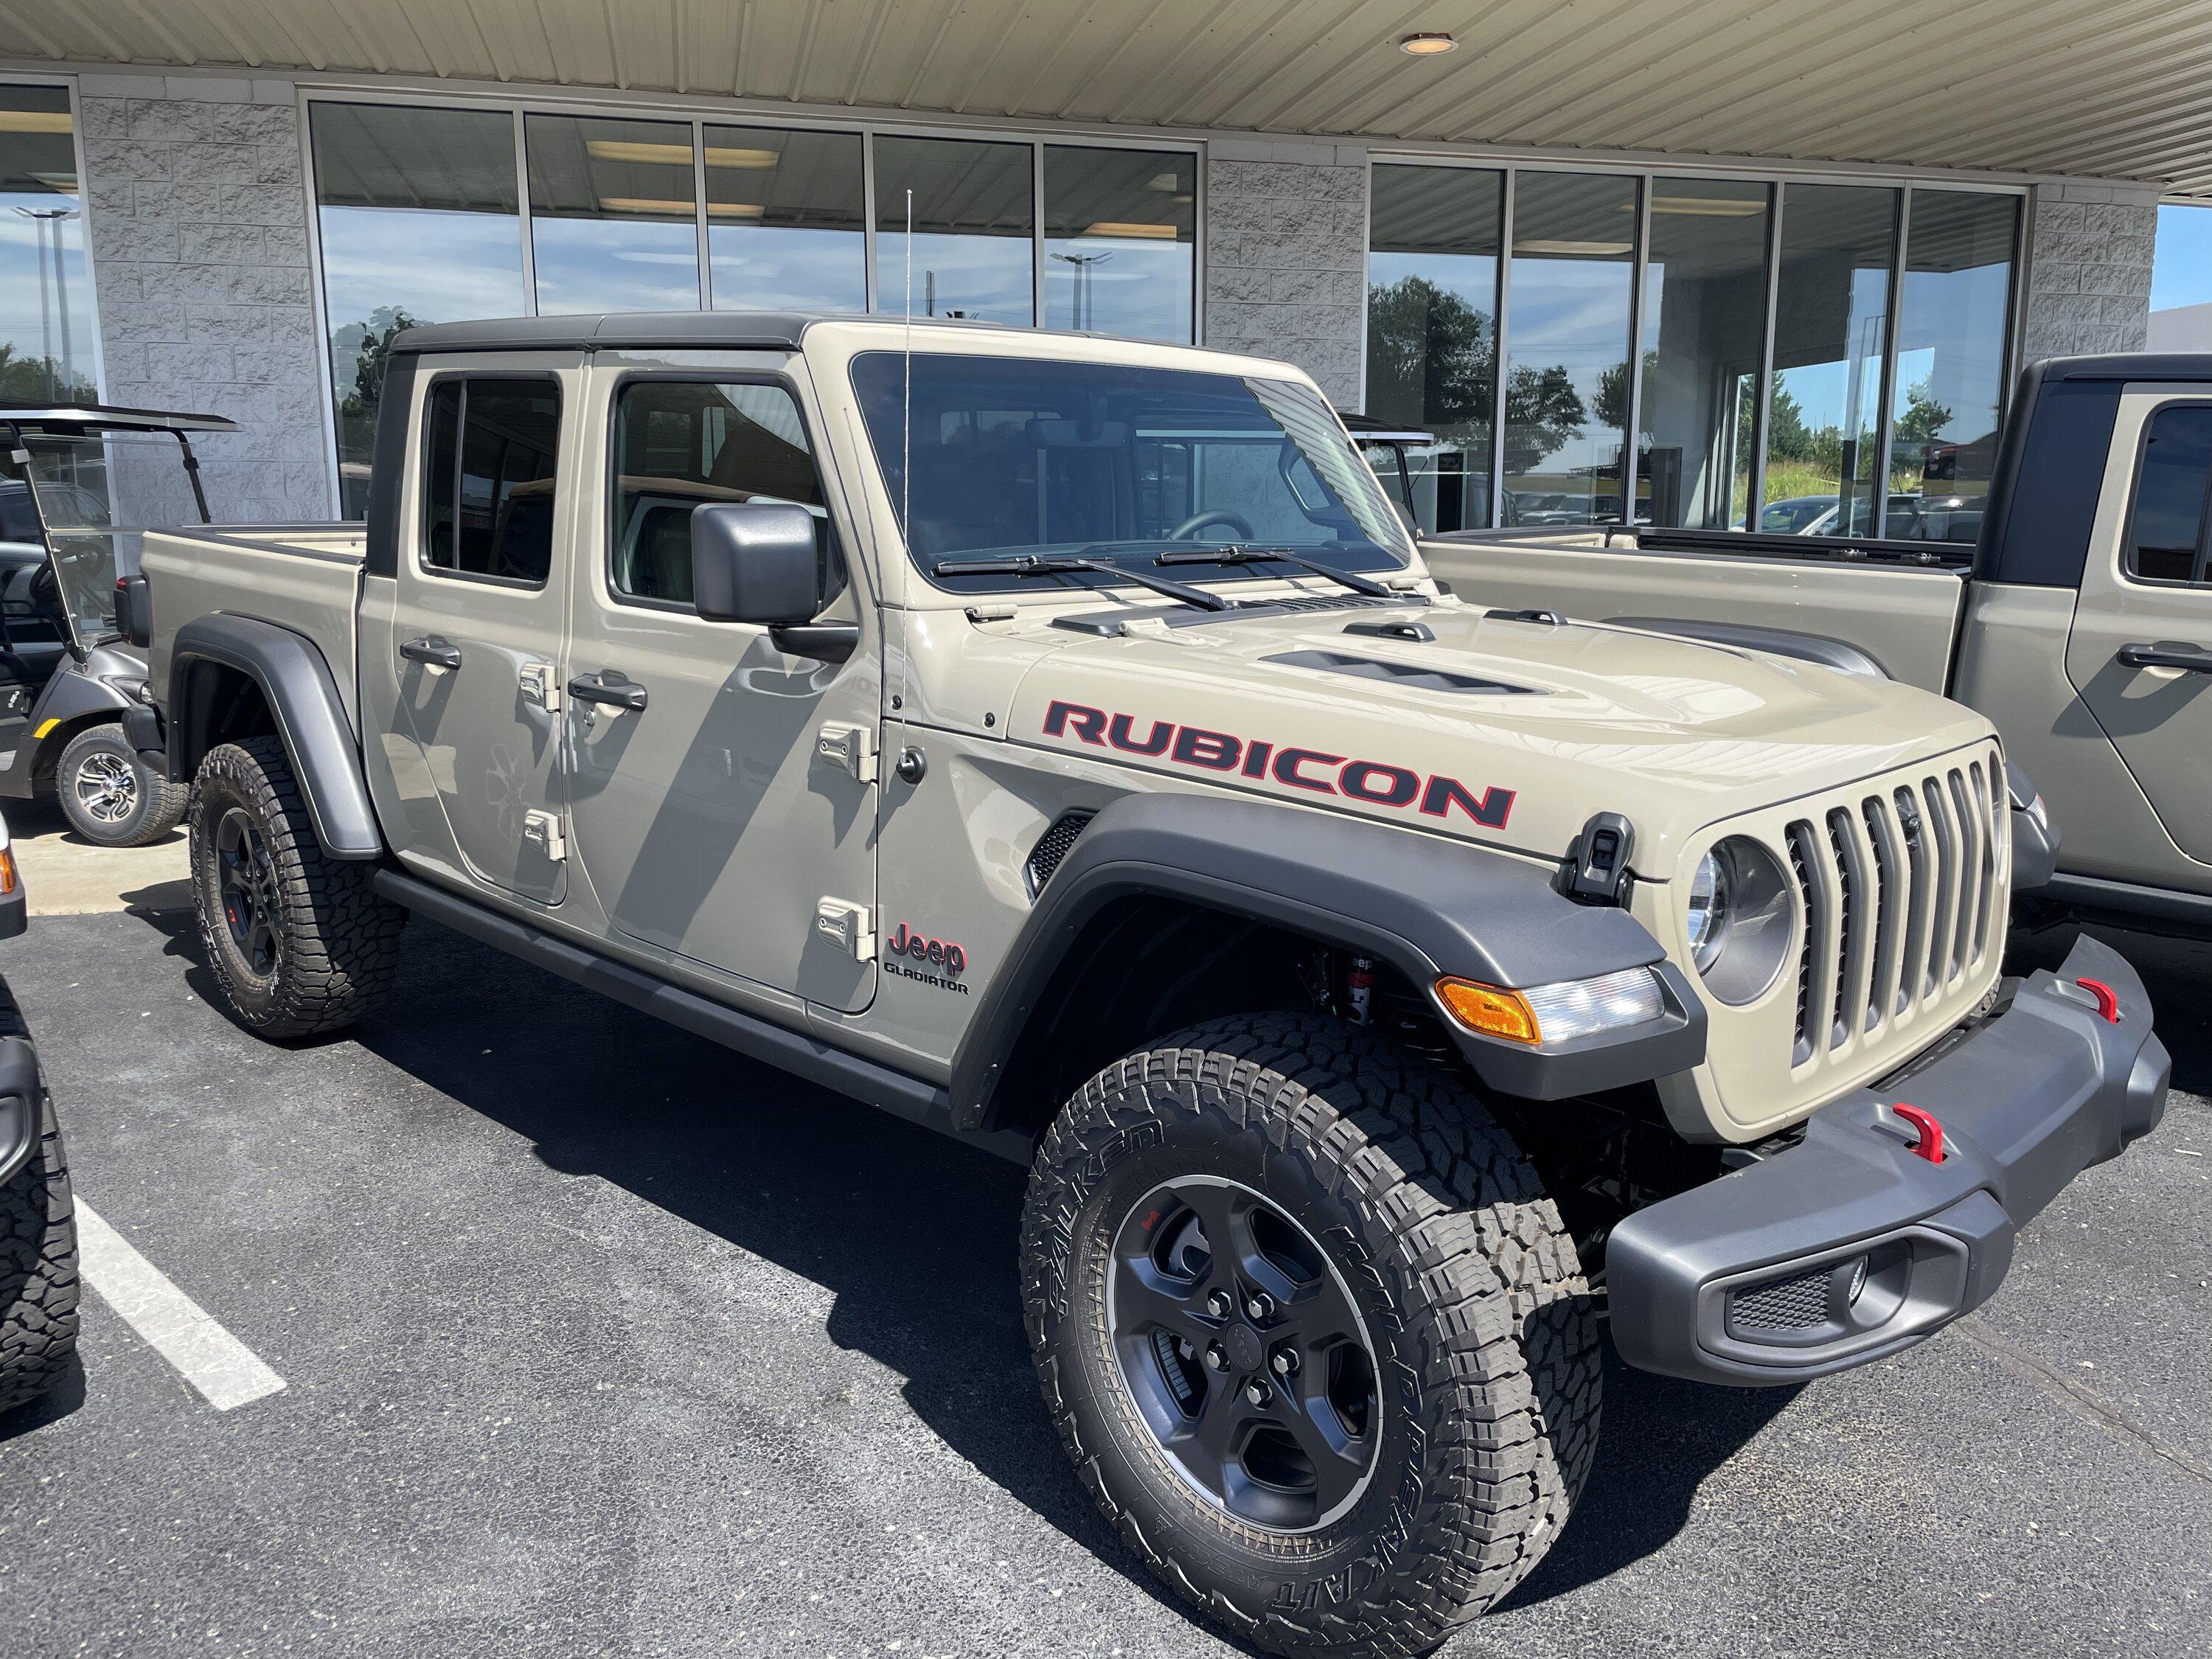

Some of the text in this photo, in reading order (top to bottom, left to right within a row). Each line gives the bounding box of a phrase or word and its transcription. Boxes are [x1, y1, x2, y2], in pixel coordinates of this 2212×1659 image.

[1042, 699, 1517, 831] RUBICON
[887, 922, 968, 977] Jeep
[1352, 957, 1373, 970] eep
[883, 961, 970, 995] GLADIATOR
[1323, 1223, 1427, 1590] WILDPEAK
